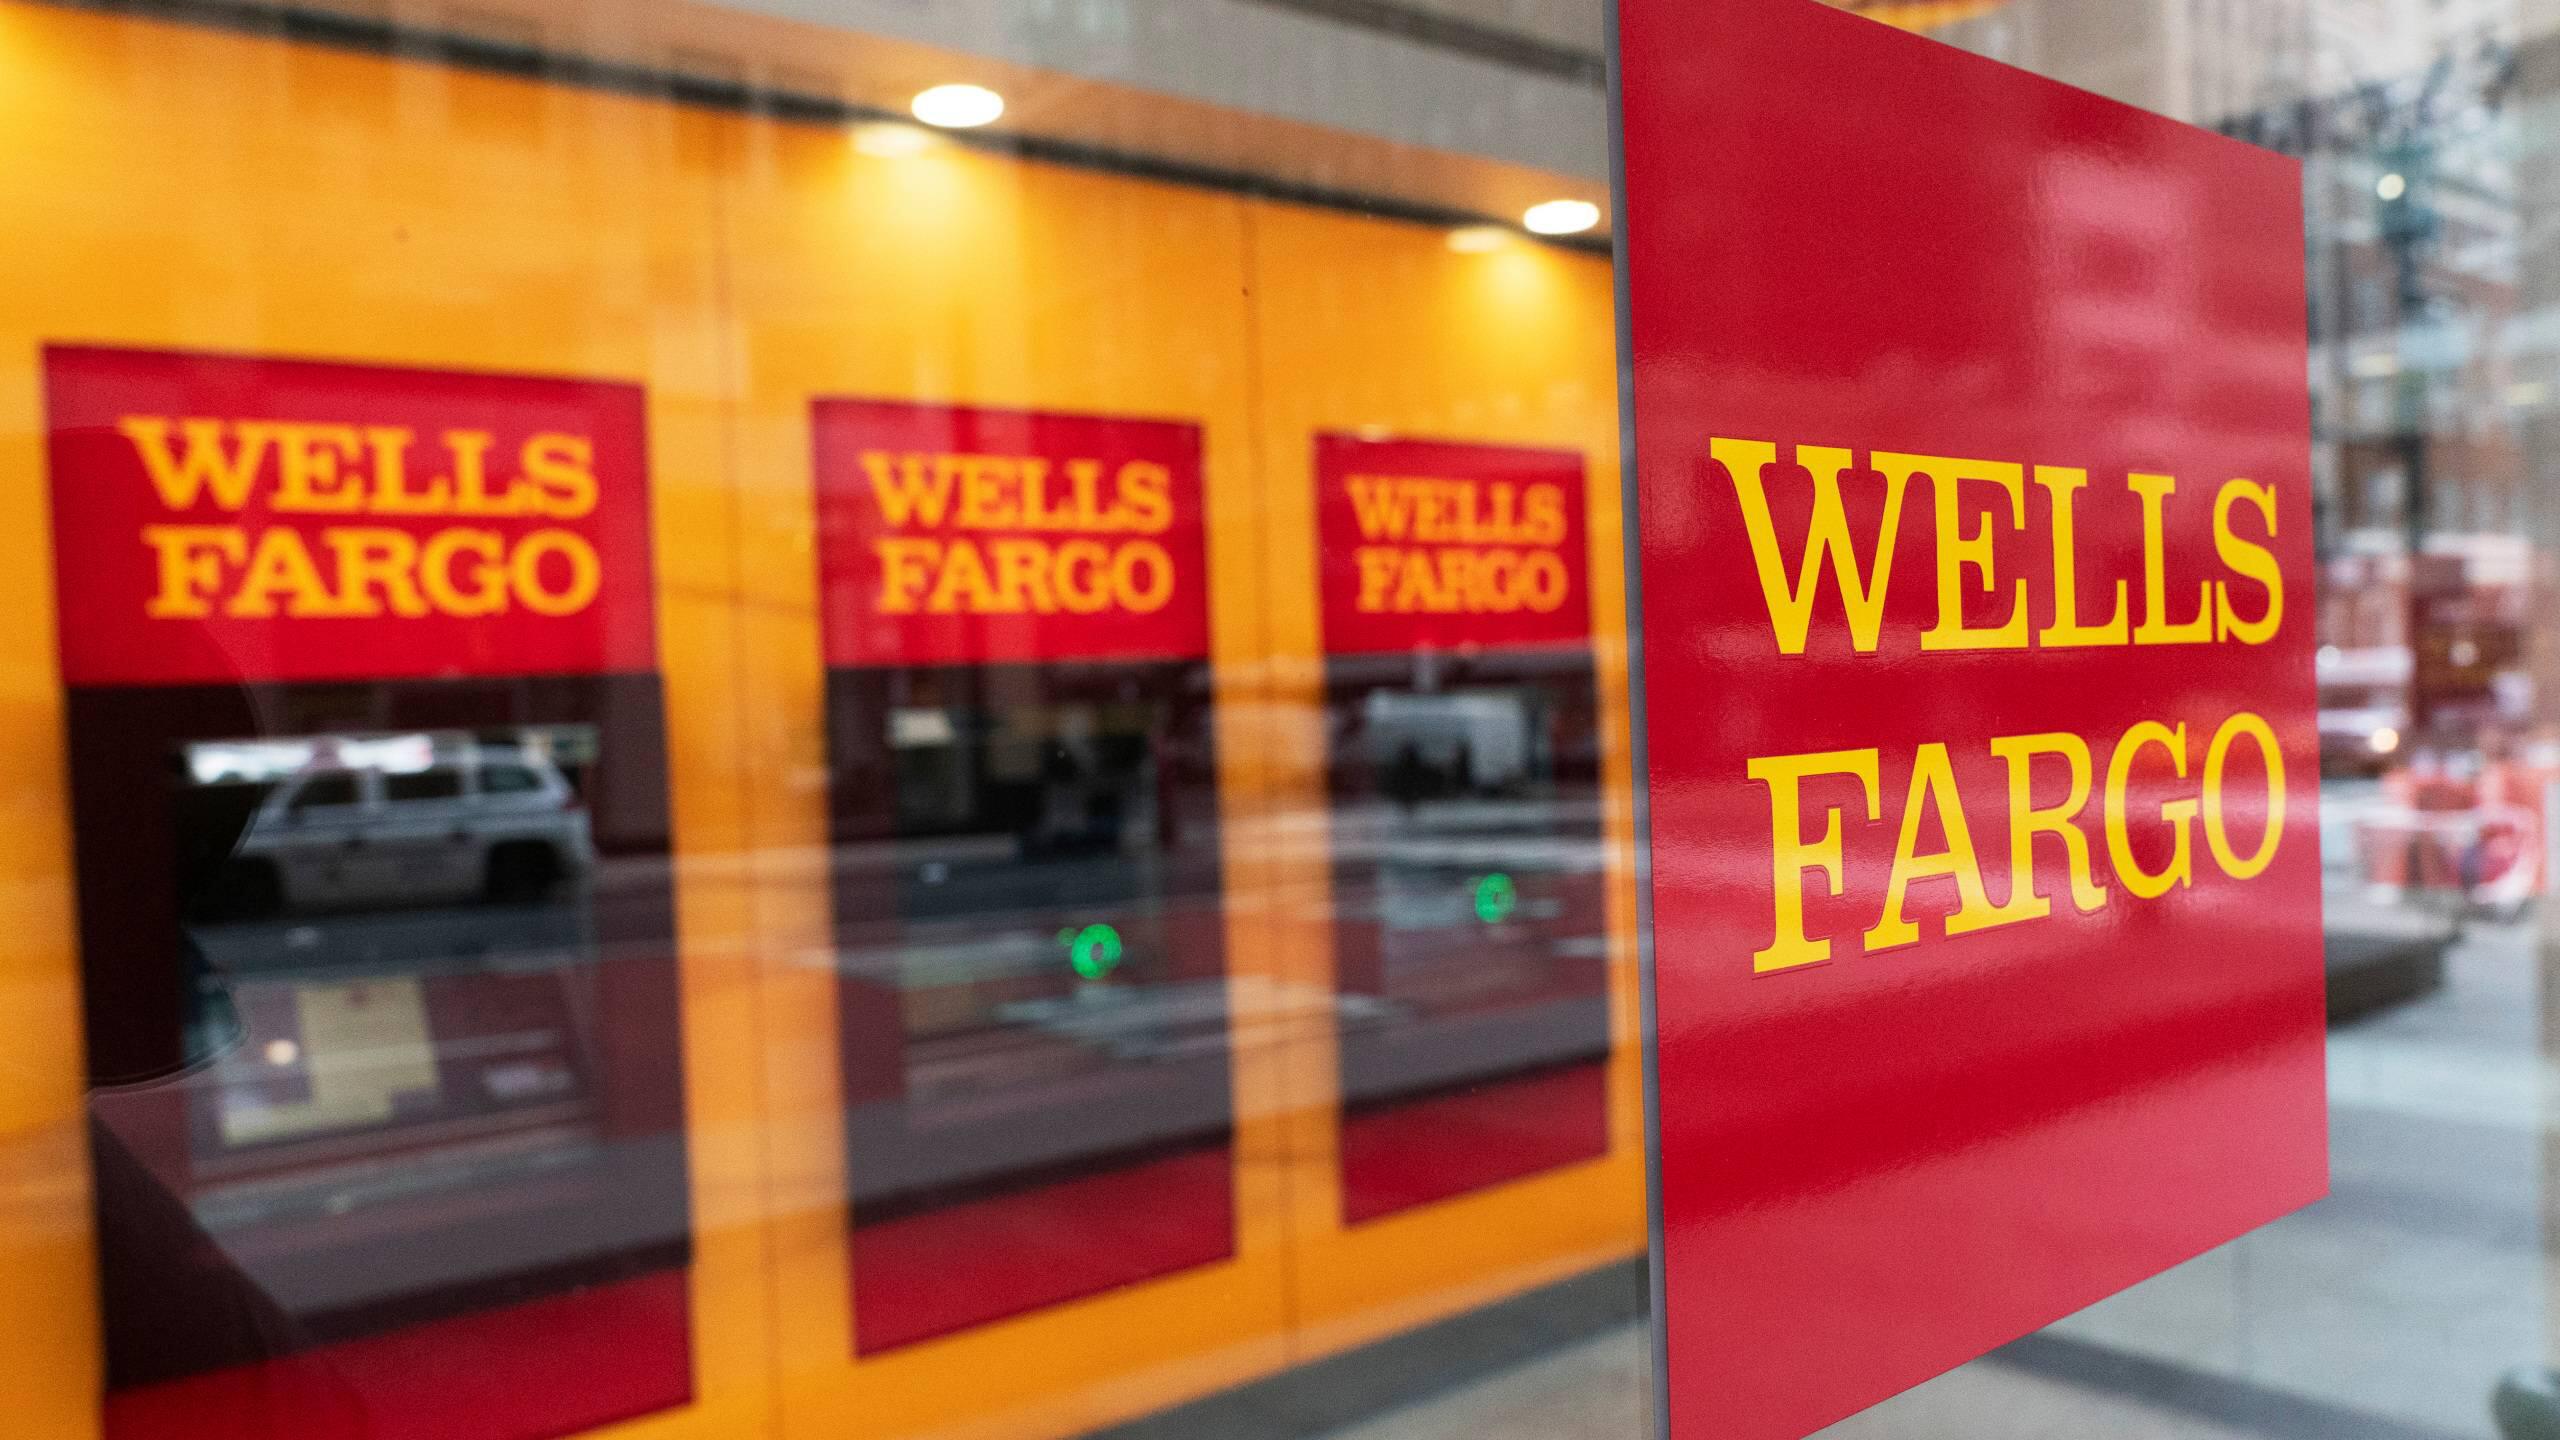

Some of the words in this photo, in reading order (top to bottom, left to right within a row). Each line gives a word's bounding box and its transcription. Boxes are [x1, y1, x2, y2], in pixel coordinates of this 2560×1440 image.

[122, 417, 599, 517] WELLS
[861, 449, 1173, 533] WELLS
[1348, 476, 1563, 544] WELLS
[146, 526, 602, 618] FARGO
[876, 537, 1174, 614] FARGO
[1359, 548, 1566, 612] FARGO
[1711, 437, 2283, 654] WELLS
[1748, 713, 2286, 973] FARGO
